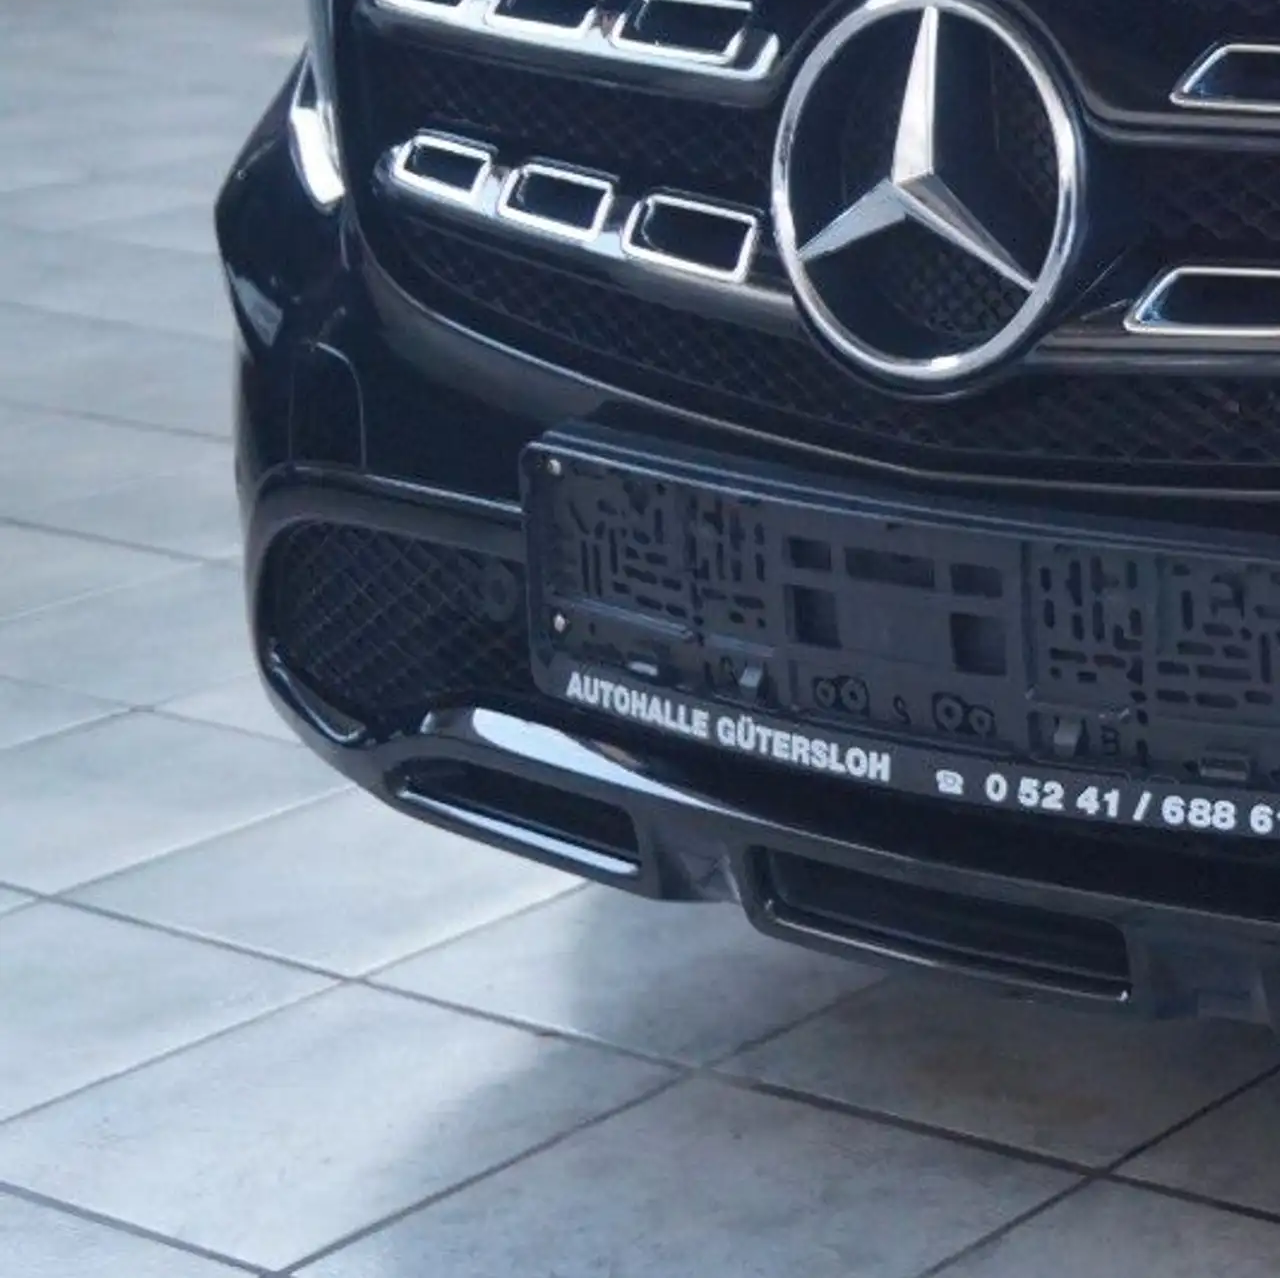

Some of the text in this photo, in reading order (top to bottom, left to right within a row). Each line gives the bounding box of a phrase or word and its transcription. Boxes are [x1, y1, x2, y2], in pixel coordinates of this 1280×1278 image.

[566, 671, 709, 740] AUTOHALLE
[716, 715, 891, 782] GÜTERSLOH
[985, 773, 1009, 802] 0
[1017, 777, 1065, 810] 52
[1076, 786, 1120, 817] 41
[1161, 795, 1237, 831] 688
